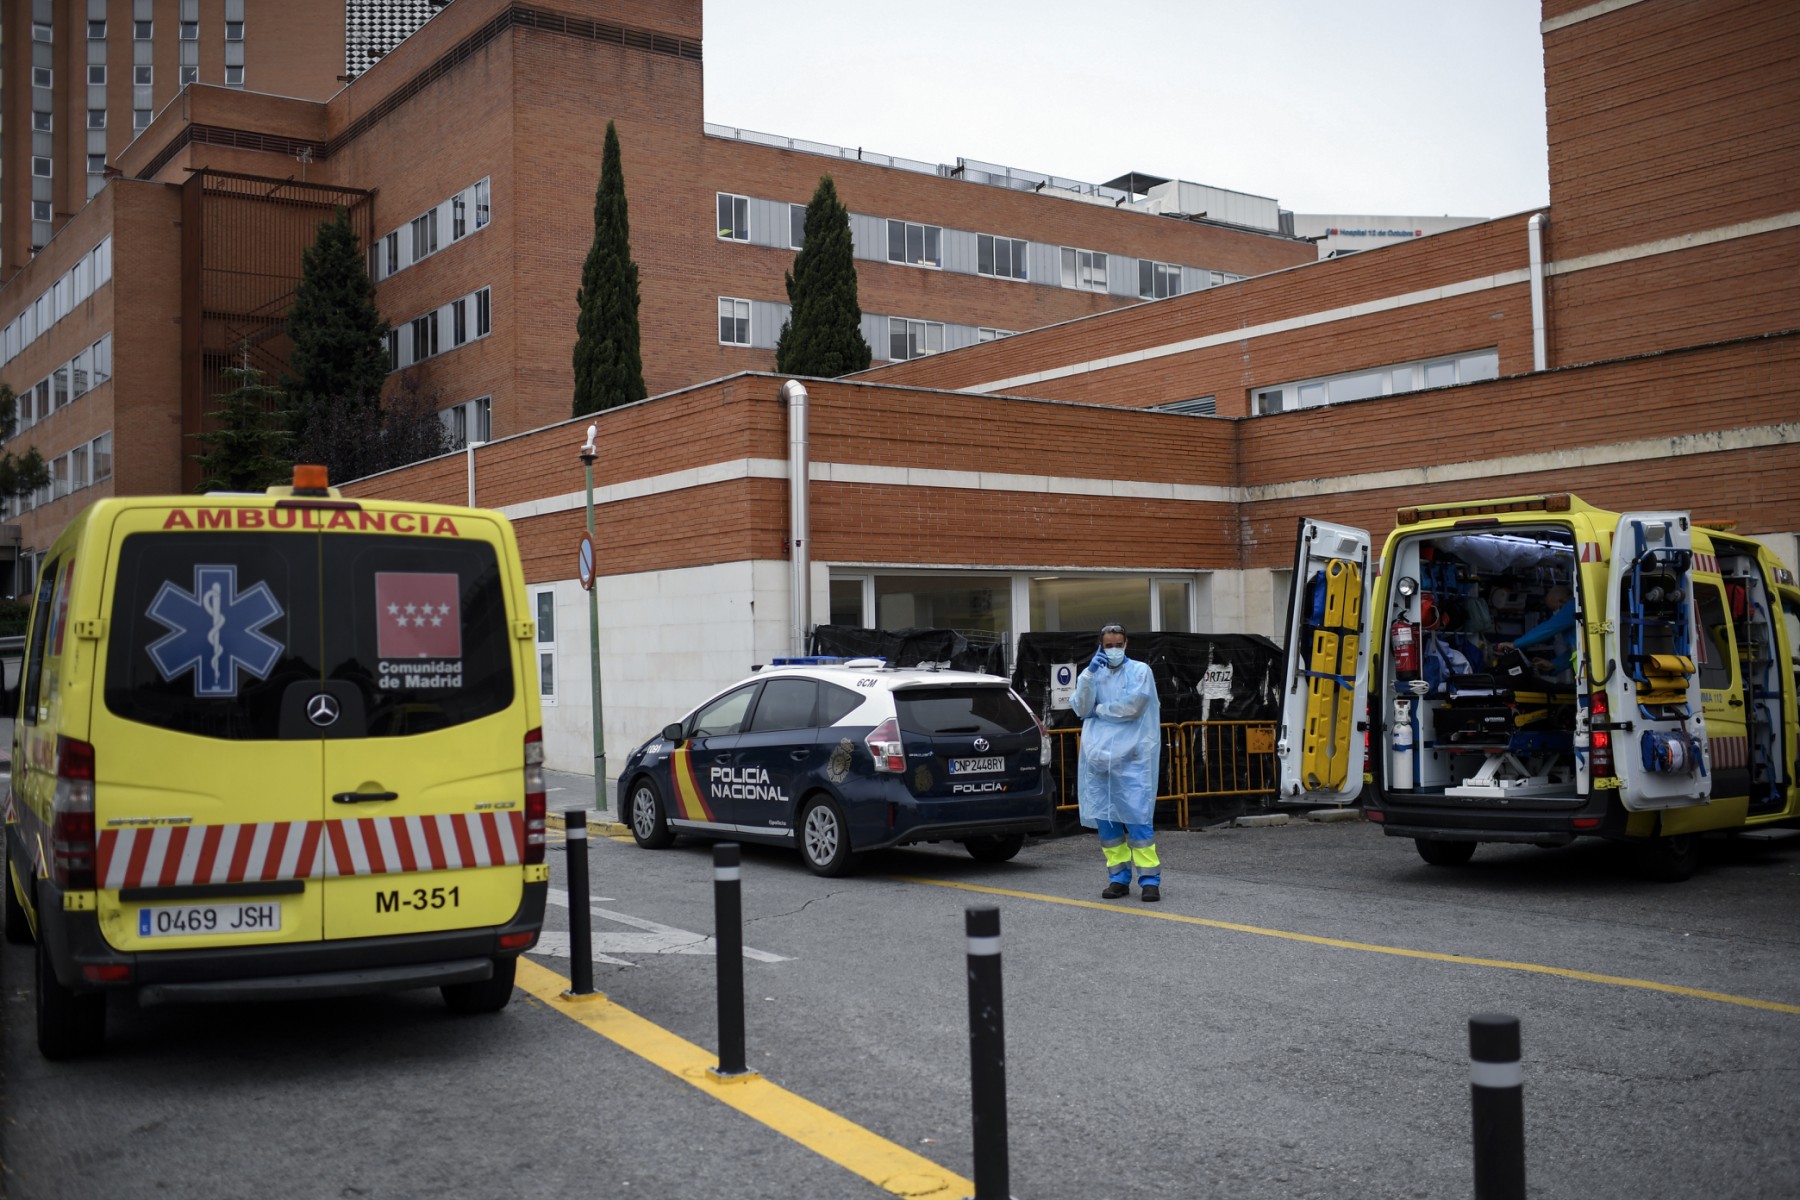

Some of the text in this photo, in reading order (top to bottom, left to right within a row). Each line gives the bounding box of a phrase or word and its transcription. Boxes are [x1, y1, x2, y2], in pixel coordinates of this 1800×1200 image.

[1340, 229, 1366, 238] Hospital
[1378, 229, 1386, 237] de
[1388, 229, 1413, 237] Octubre
[162, 508, 460, 537] AMBULANCIA
[378, 661, 462, 674] Comunidad
[379, 675, 462, 688] de Madrid
[856, 678, 878, 688] 6CM
[711, 765, 770, 785] POLICÍA
[711, 784, 789, 801] NACIONAL
[953, 782, 1003, 793] POLICÍA
[375, 886, 460, 914] M-351
[157, 908, 218, 933] 0469
[230, 906, 273, 929] JSH
